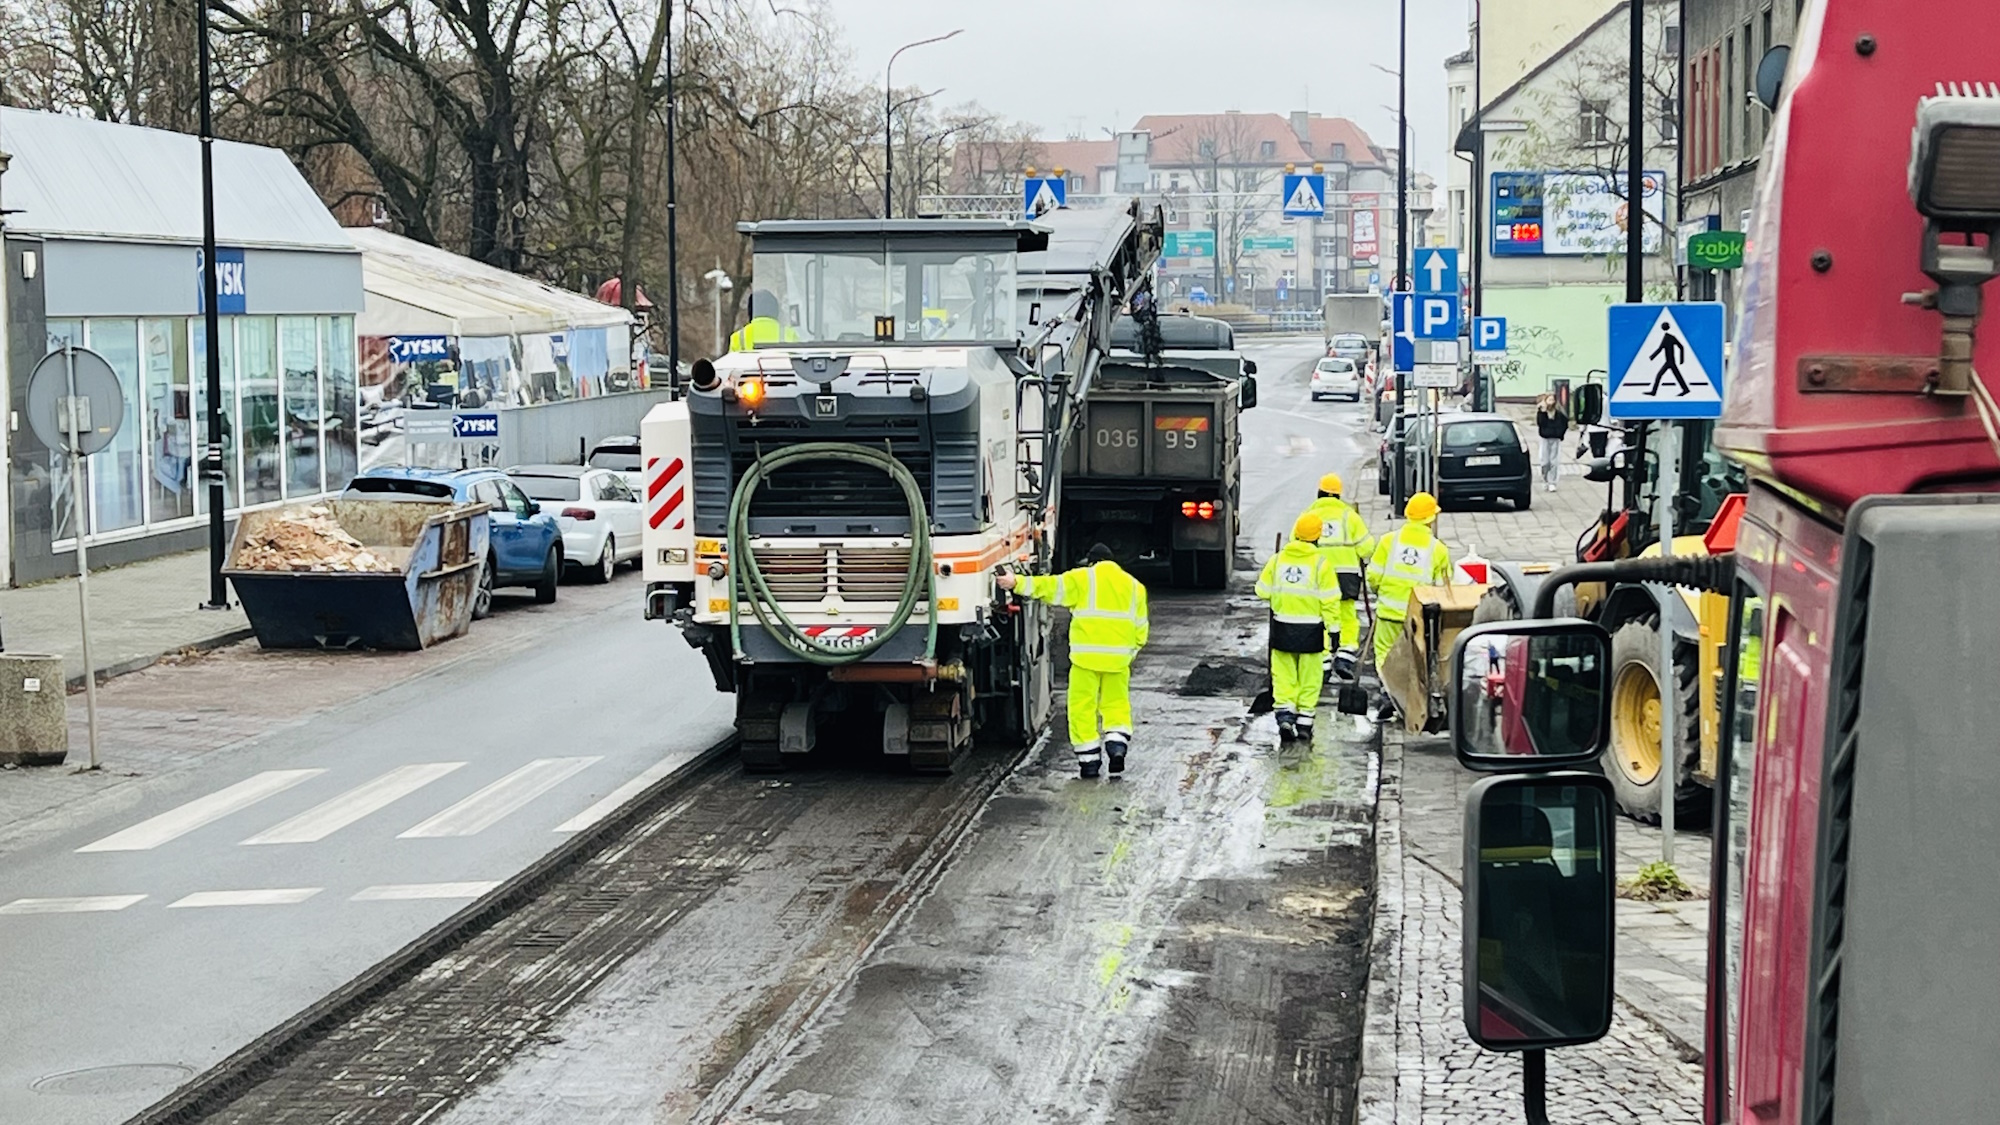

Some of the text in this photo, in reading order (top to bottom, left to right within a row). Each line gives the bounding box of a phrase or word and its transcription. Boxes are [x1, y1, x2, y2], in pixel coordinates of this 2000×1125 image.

[1695, 240, 1743, 255] żabk
[215, 262, 245, 295] YSK
[1423, 299, 1450, 335] P
[1480, 320, 1500, 347] P
[401, 339, 446, 356] JYSK
[461, 419, 497, 432] JYSK
[1096, 429, 1197, 449] 036 95
